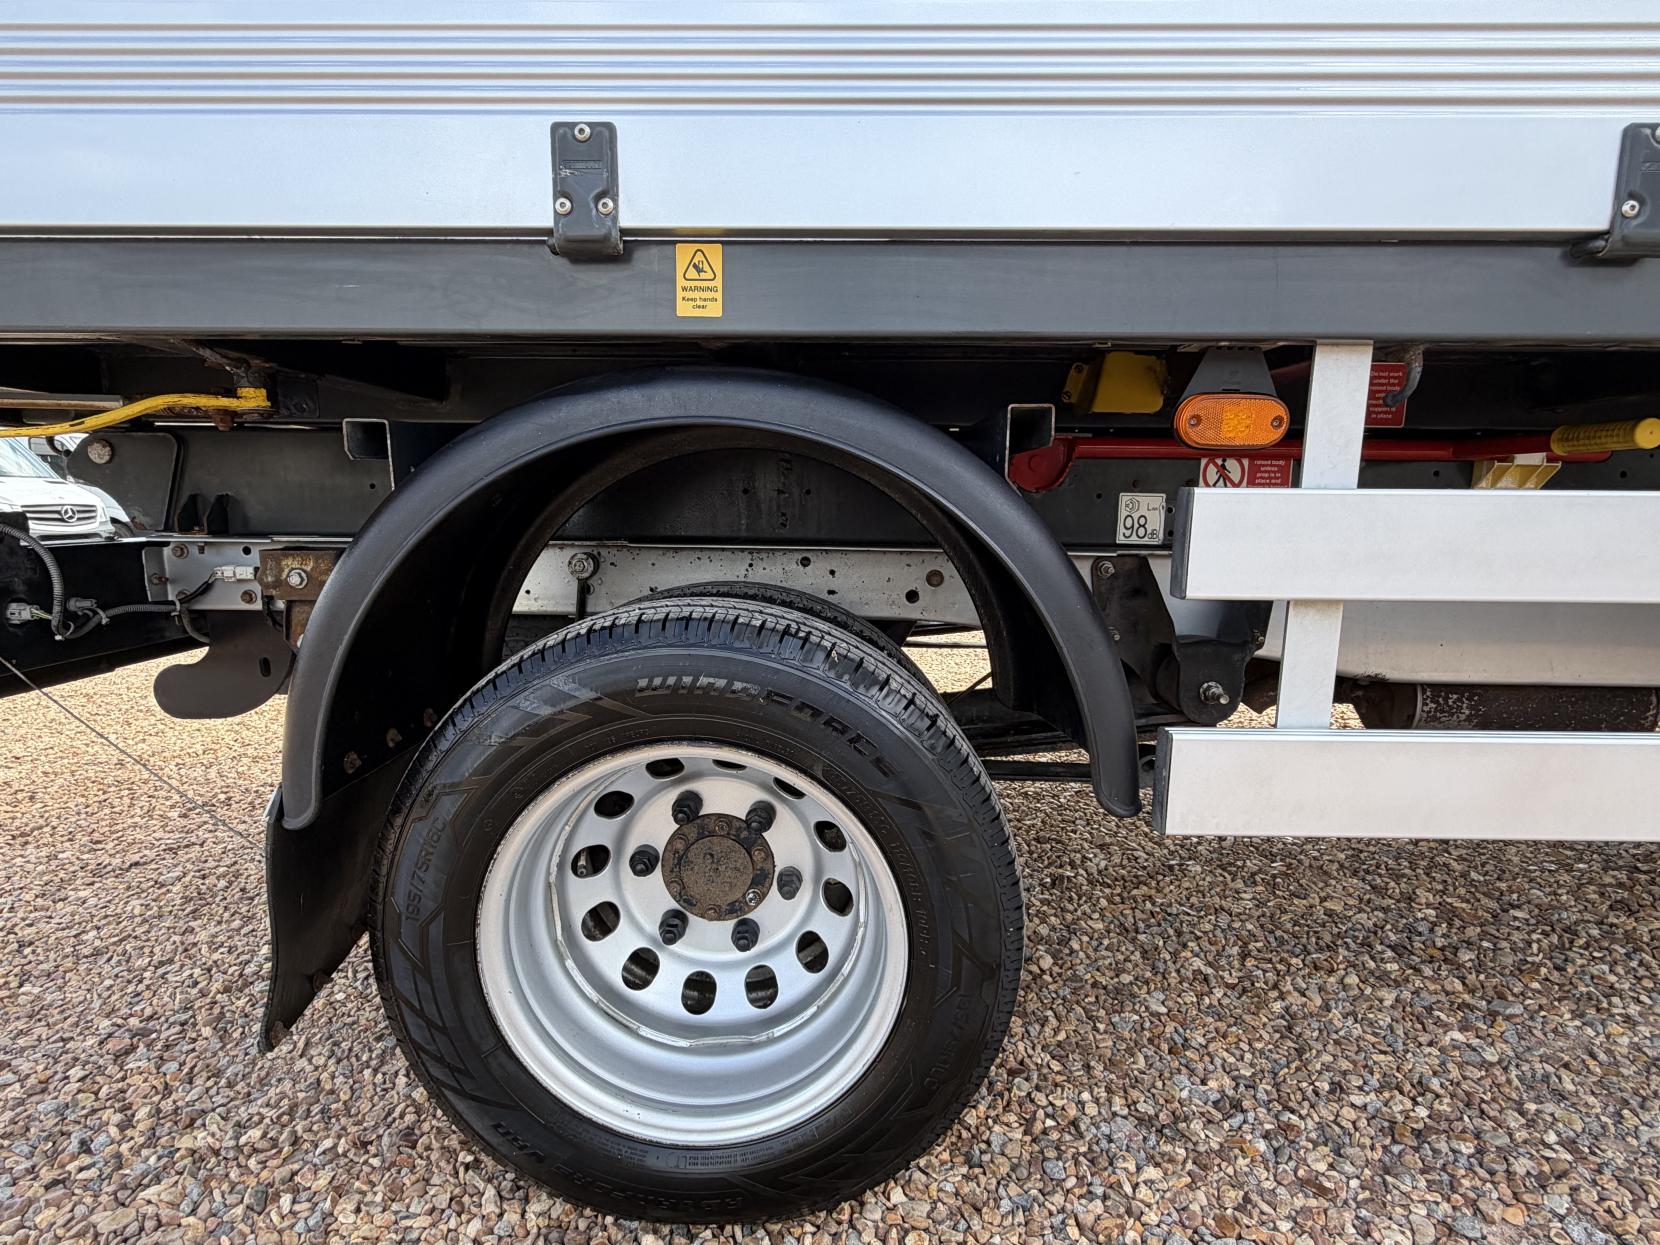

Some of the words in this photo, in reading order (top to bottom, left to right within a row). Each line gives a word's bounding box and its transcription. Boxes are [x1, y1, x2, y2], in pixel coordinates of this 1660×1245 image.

[681, 285, 719, 293] WARNING
[1122, 514, 1148, 540] 98
[1147, 528, 1158, 540] dB
[633, 674, 898, 779] WINDFORCE
